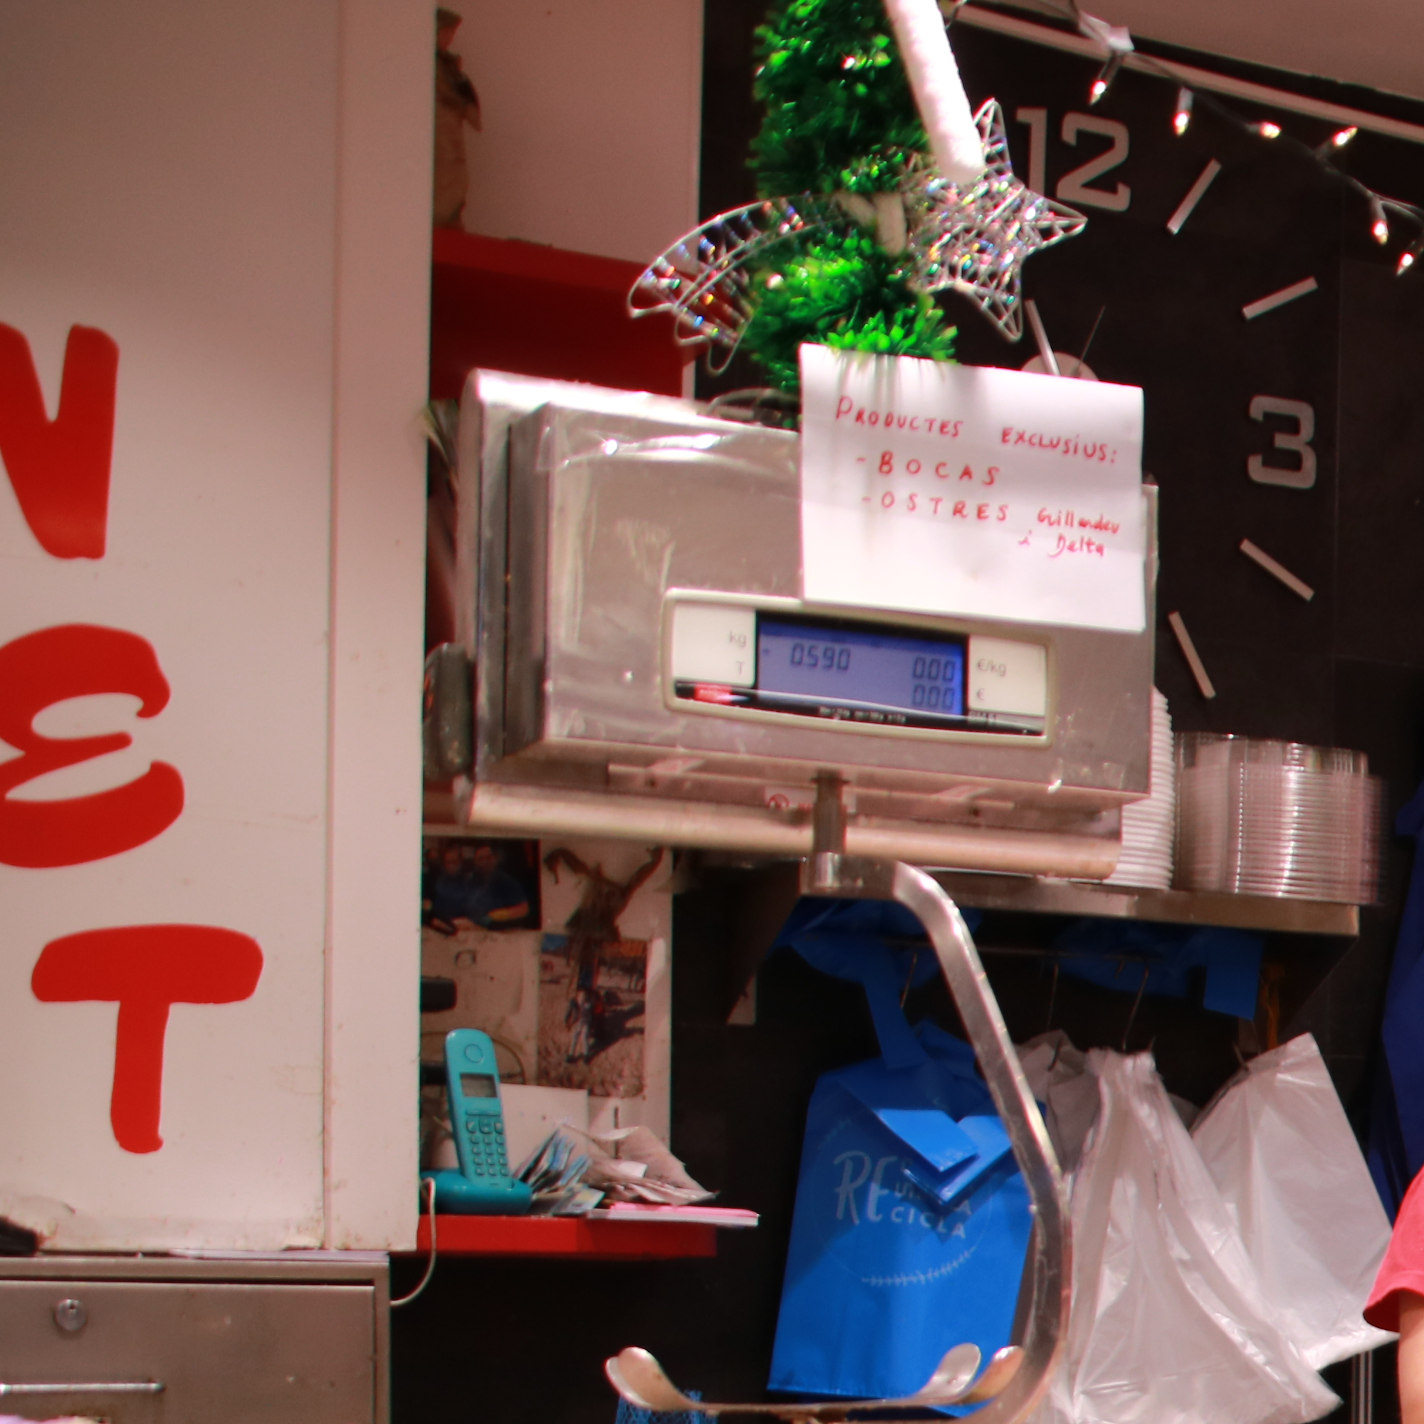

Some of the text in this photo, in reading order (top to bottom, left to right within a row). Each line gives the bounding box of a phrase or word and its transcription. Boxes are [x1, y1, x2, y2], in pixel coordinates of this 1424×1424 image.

[1017, 109, 1131, 212] 12
[1248, 396, 1317, 489] 3
[878, 451, 1000, 486] BOCAS
[881, 492, 1009, 522] OSTRES
[1047, 535, 1105, 558] Delta
